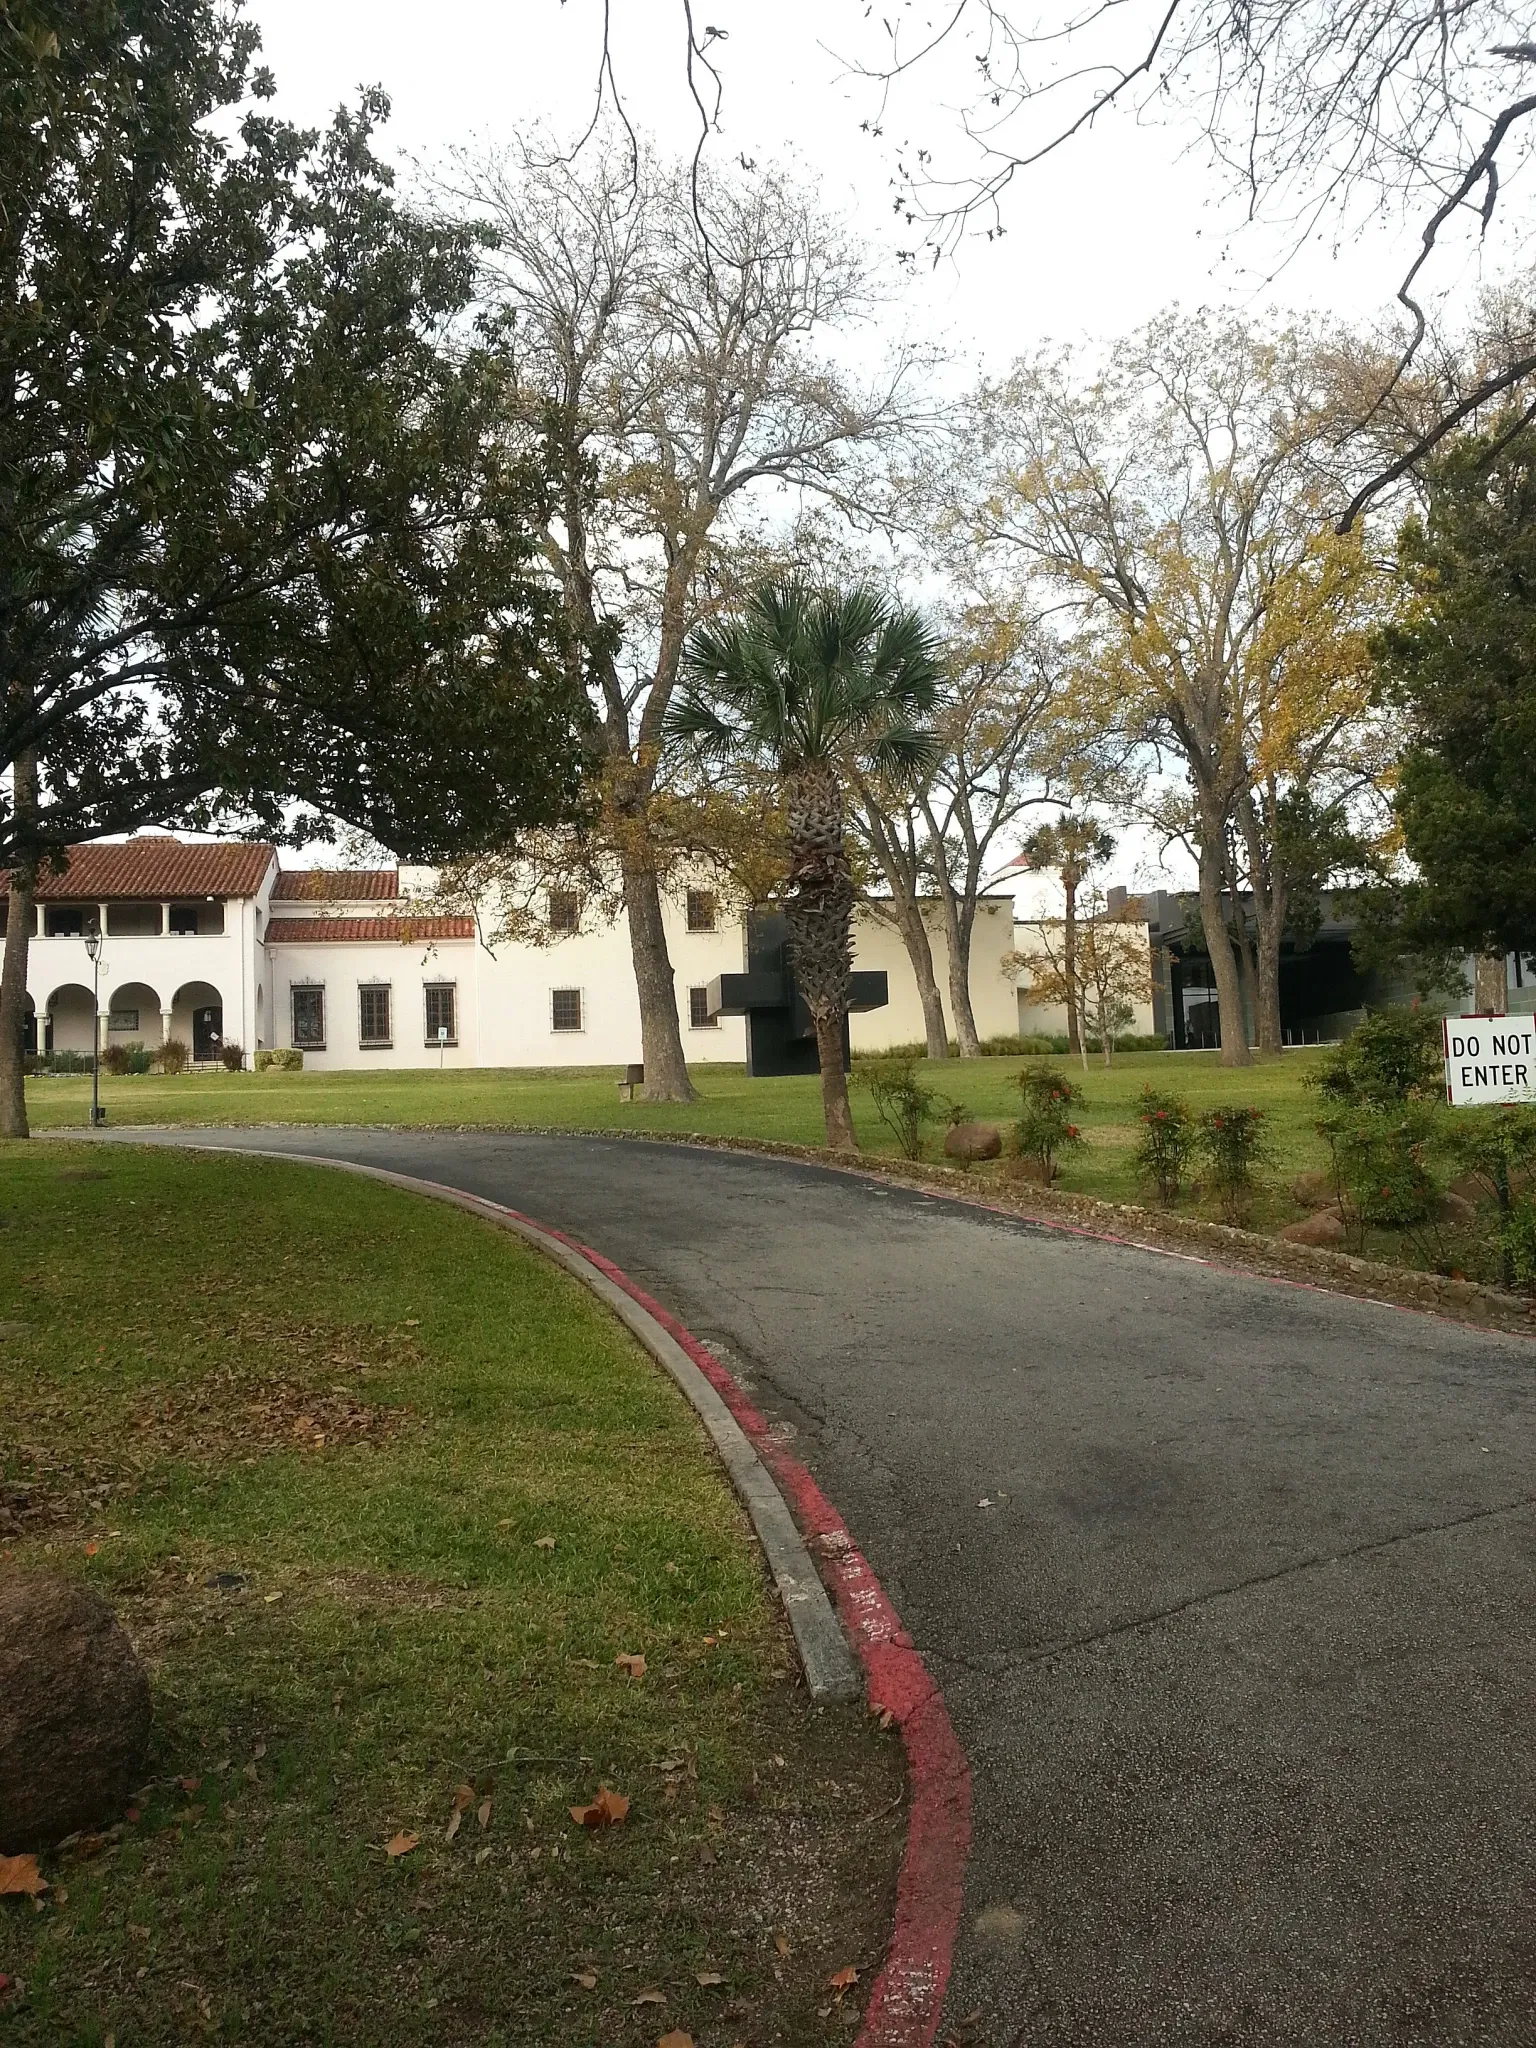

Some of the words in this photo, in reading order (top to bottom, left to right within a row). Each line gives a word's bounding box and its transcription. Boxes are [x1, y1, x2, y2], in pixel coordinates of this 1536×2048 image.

[1452, 1036, 1480, 1058] DO
[1492, 1034, 1532, 1056] NOT
[1461, 1064, 1528, 1087] ENTER
